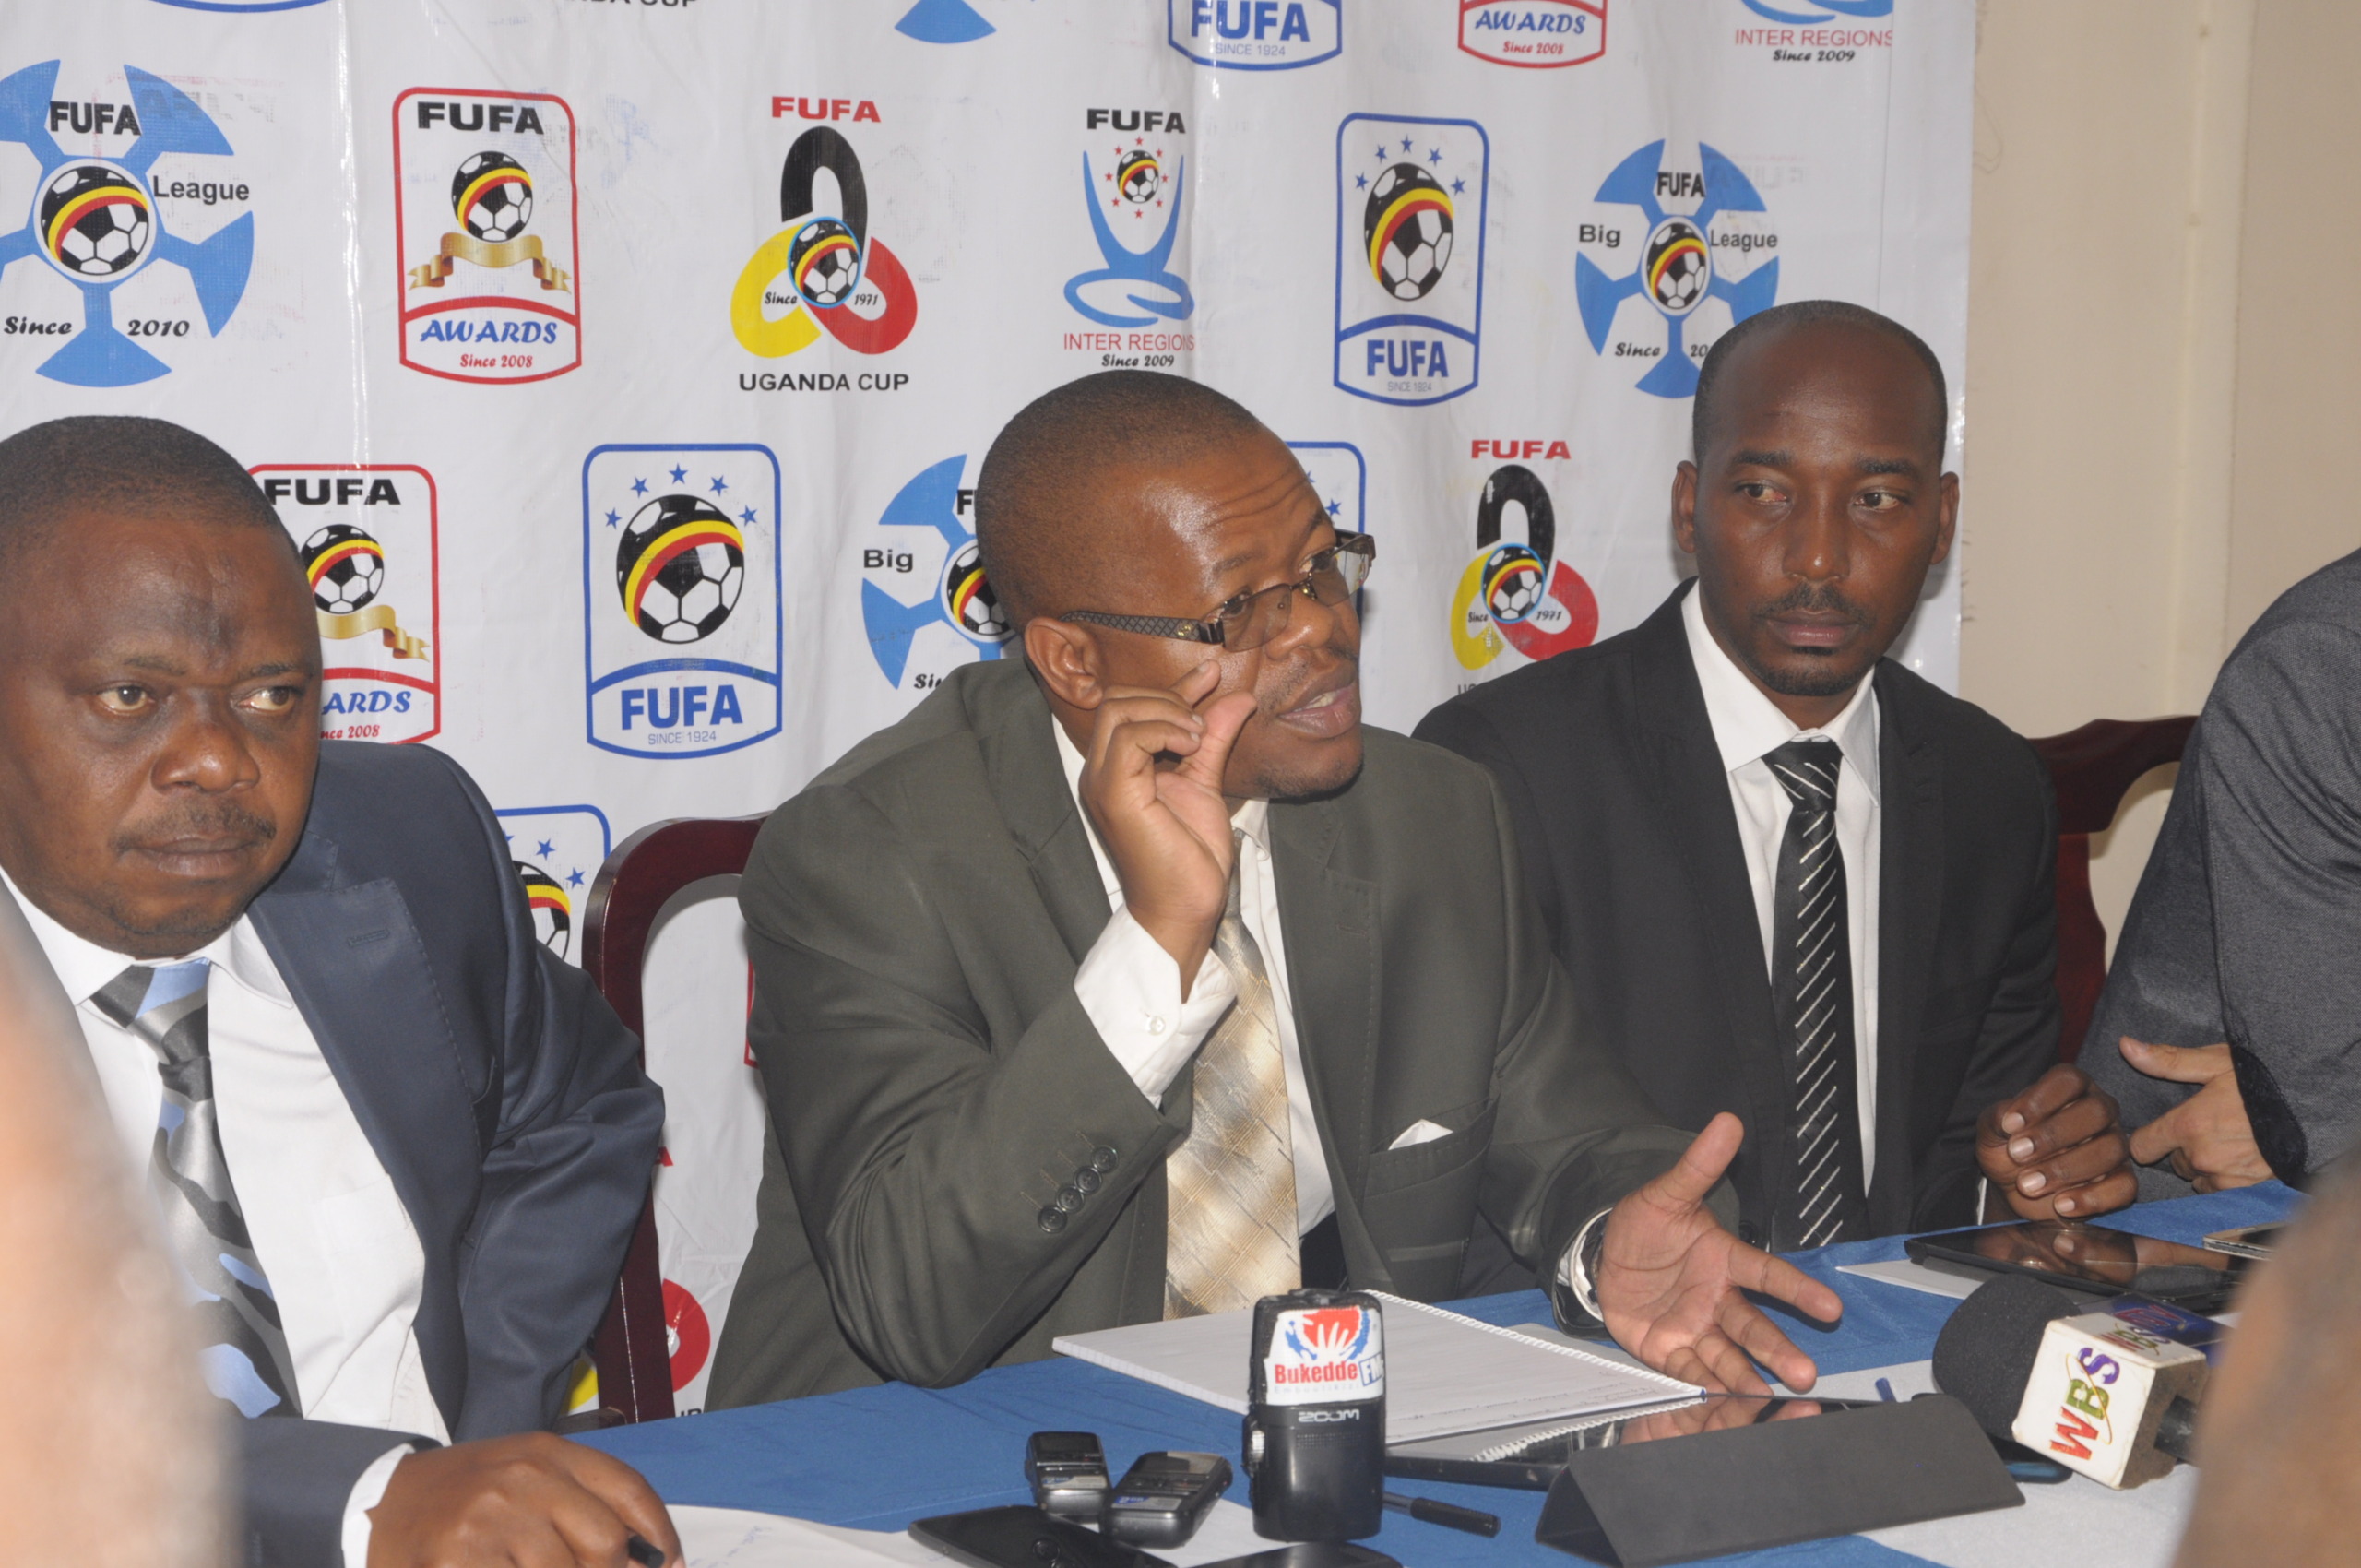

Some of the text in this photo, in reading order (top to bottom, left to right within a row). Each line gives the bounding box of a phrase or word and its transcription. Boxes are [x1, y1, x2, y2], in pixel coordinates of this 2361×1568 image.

[1191, 0, 1311, 42] FUFA
[1475, 10, 1586, 35] AWARDS
[1215, 42, 1286, 56] SINCE 1924
[1503, 41, 1564, 55] Since 2008
[1735, 29, 1893, 47] INTER REGIONS
[1773, 49, 1856, 62] Since 2009
[49, 101, 142, 137] FUFA
[417, 101, 545, 136] FUFA
[771, 96, 883, 124] FUFA
[1086, 108, 1187, 134] FUFA
[152, 175, 250, 206] League
[1656, 172, 1705, 197] FUFA
[1578, 224, 1621, 248] Big
[1710, 229, 1778, 253] League
[765, 291, 879, 306] Since 1971
[3, 316, 191, 337] Since 2010
[420, 319, 558, 345] AWARDS
[1063, 333, 1195, 351] INTER REGIONS
[1615, 342, 1709, 358] Since 20
[459, 353, 533, 369] Since 2008
[1101, 354, 1175, 367] Since 2009
[1367, 339, 1449, 377] FUFA
[739, 374, 909, 392] UGANDA CUP
[1387, 381, 1432, 393] SINCE 1924
[1471, 439, 1572, 460] FUFA
[264, 478, 401, 505] FUFA
[863, 549, 914, 573] Big
[1468, 610, 1562, 623] Since 1971
[322, 690, 411, 715] ARDS
[621, 684, 743, 731] FUFA
[348, 725, 380, 739] 2008
[647, 731, 717, 745] SINCE 1924
[1274, 1360, 1358, 1384] Bukedde
[1298, 1408, 1360, 1423] ZOOM
[2049, 1347, 2120, 1461] WBS
